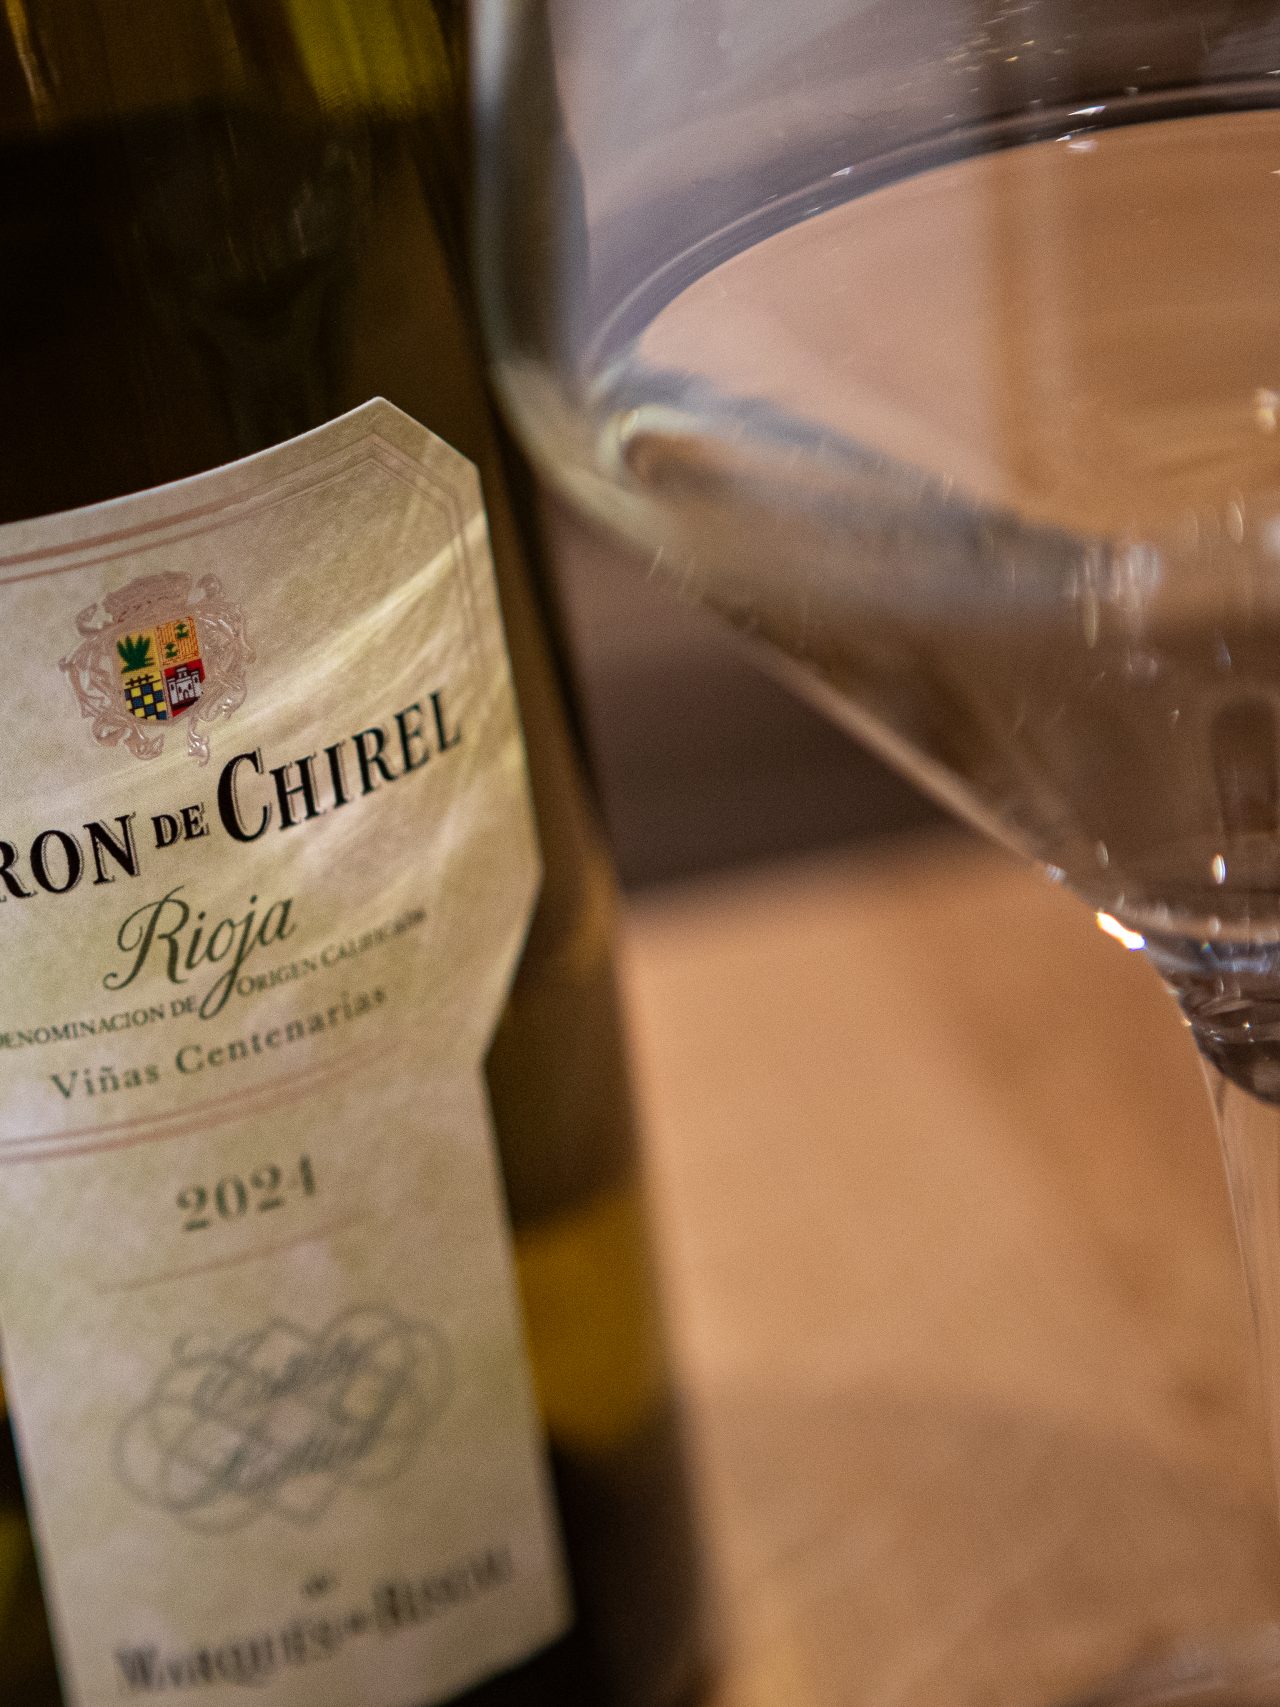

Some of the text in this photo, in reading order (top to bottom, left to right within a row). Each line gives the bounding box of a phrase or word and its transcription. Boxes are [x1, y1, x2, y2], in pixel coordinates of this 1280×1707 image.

[151, 802, 211, 850] DE
[217, 689, 463, 843] CHIREL
[102, 885, 298, 1020] Rioja
[170, 994, 201, 1018] DE
[51, 985, 388, 1100] Viñas Centenarias
